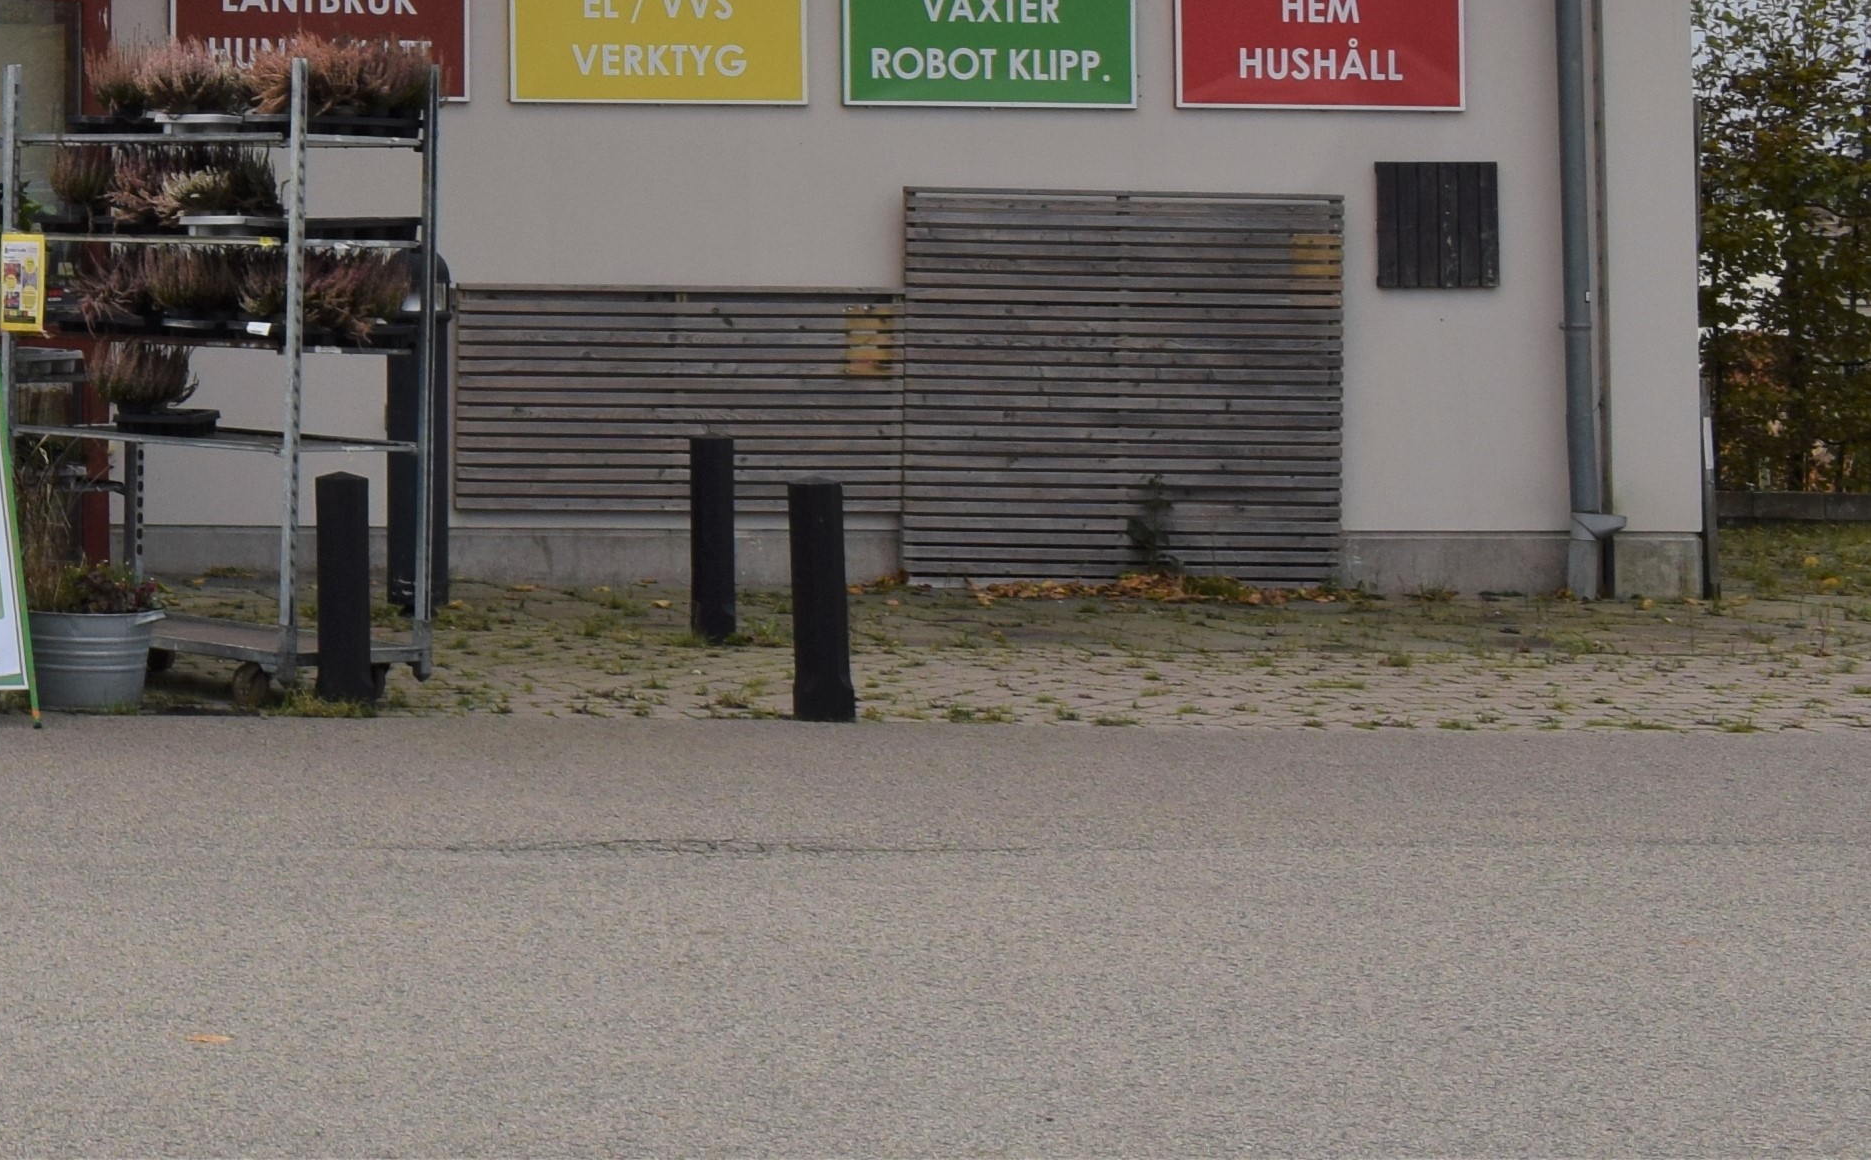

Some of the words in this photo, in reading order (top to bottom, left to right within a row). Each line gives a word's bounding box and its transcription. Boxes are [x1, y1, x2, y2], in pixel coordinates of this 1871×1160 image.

[208, 37, 300, 71] HUN
[573, 44, 746, 77] VERKTYG
[872, 47, 996, 80] ROBOT
[1010, 49, 1110, 81] KLIPP.
[1240, 38, 1403, 80] HUSHÅLL
